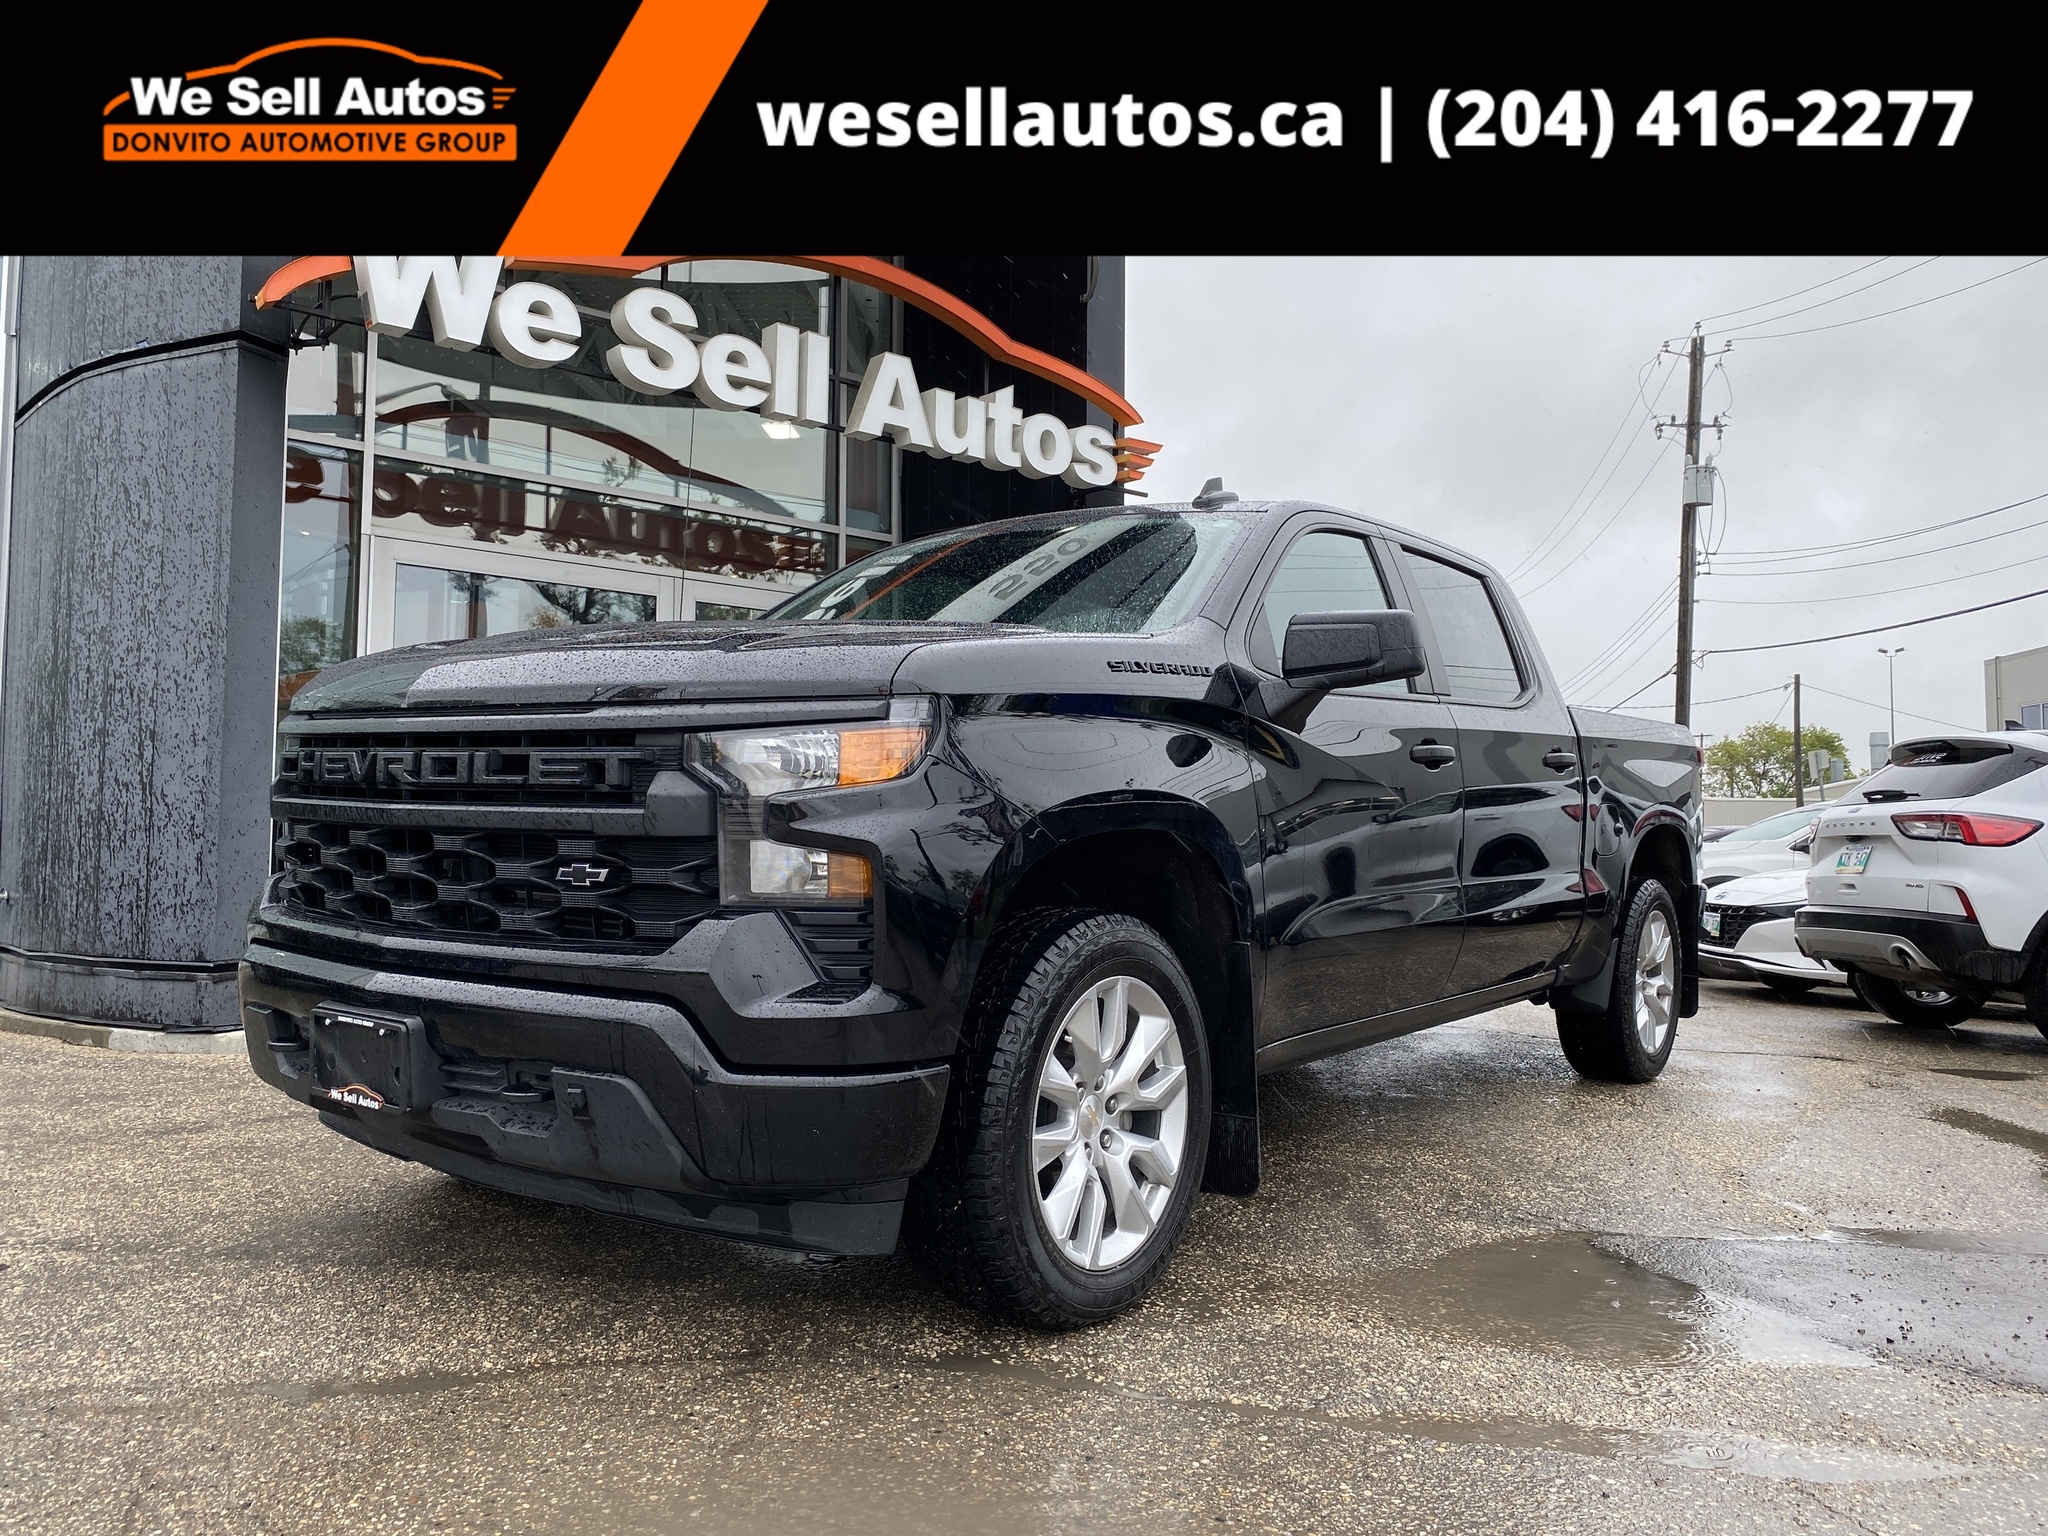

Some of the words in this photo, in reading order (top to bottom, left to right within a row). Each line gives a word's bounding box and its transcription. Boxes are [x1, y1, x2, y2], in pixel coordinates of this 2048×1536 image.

[353, 256, 582, 369] We
[606, 287, 830, 429] Sell
[844, 350, 1120, 489] Autos
[280, 750, 648, 788] CHEVROLET
[330, 1088, 342, 1100] We
[343, 1091, 357, 1104] Sell
[358, 1095, 379, 1110] Autos
